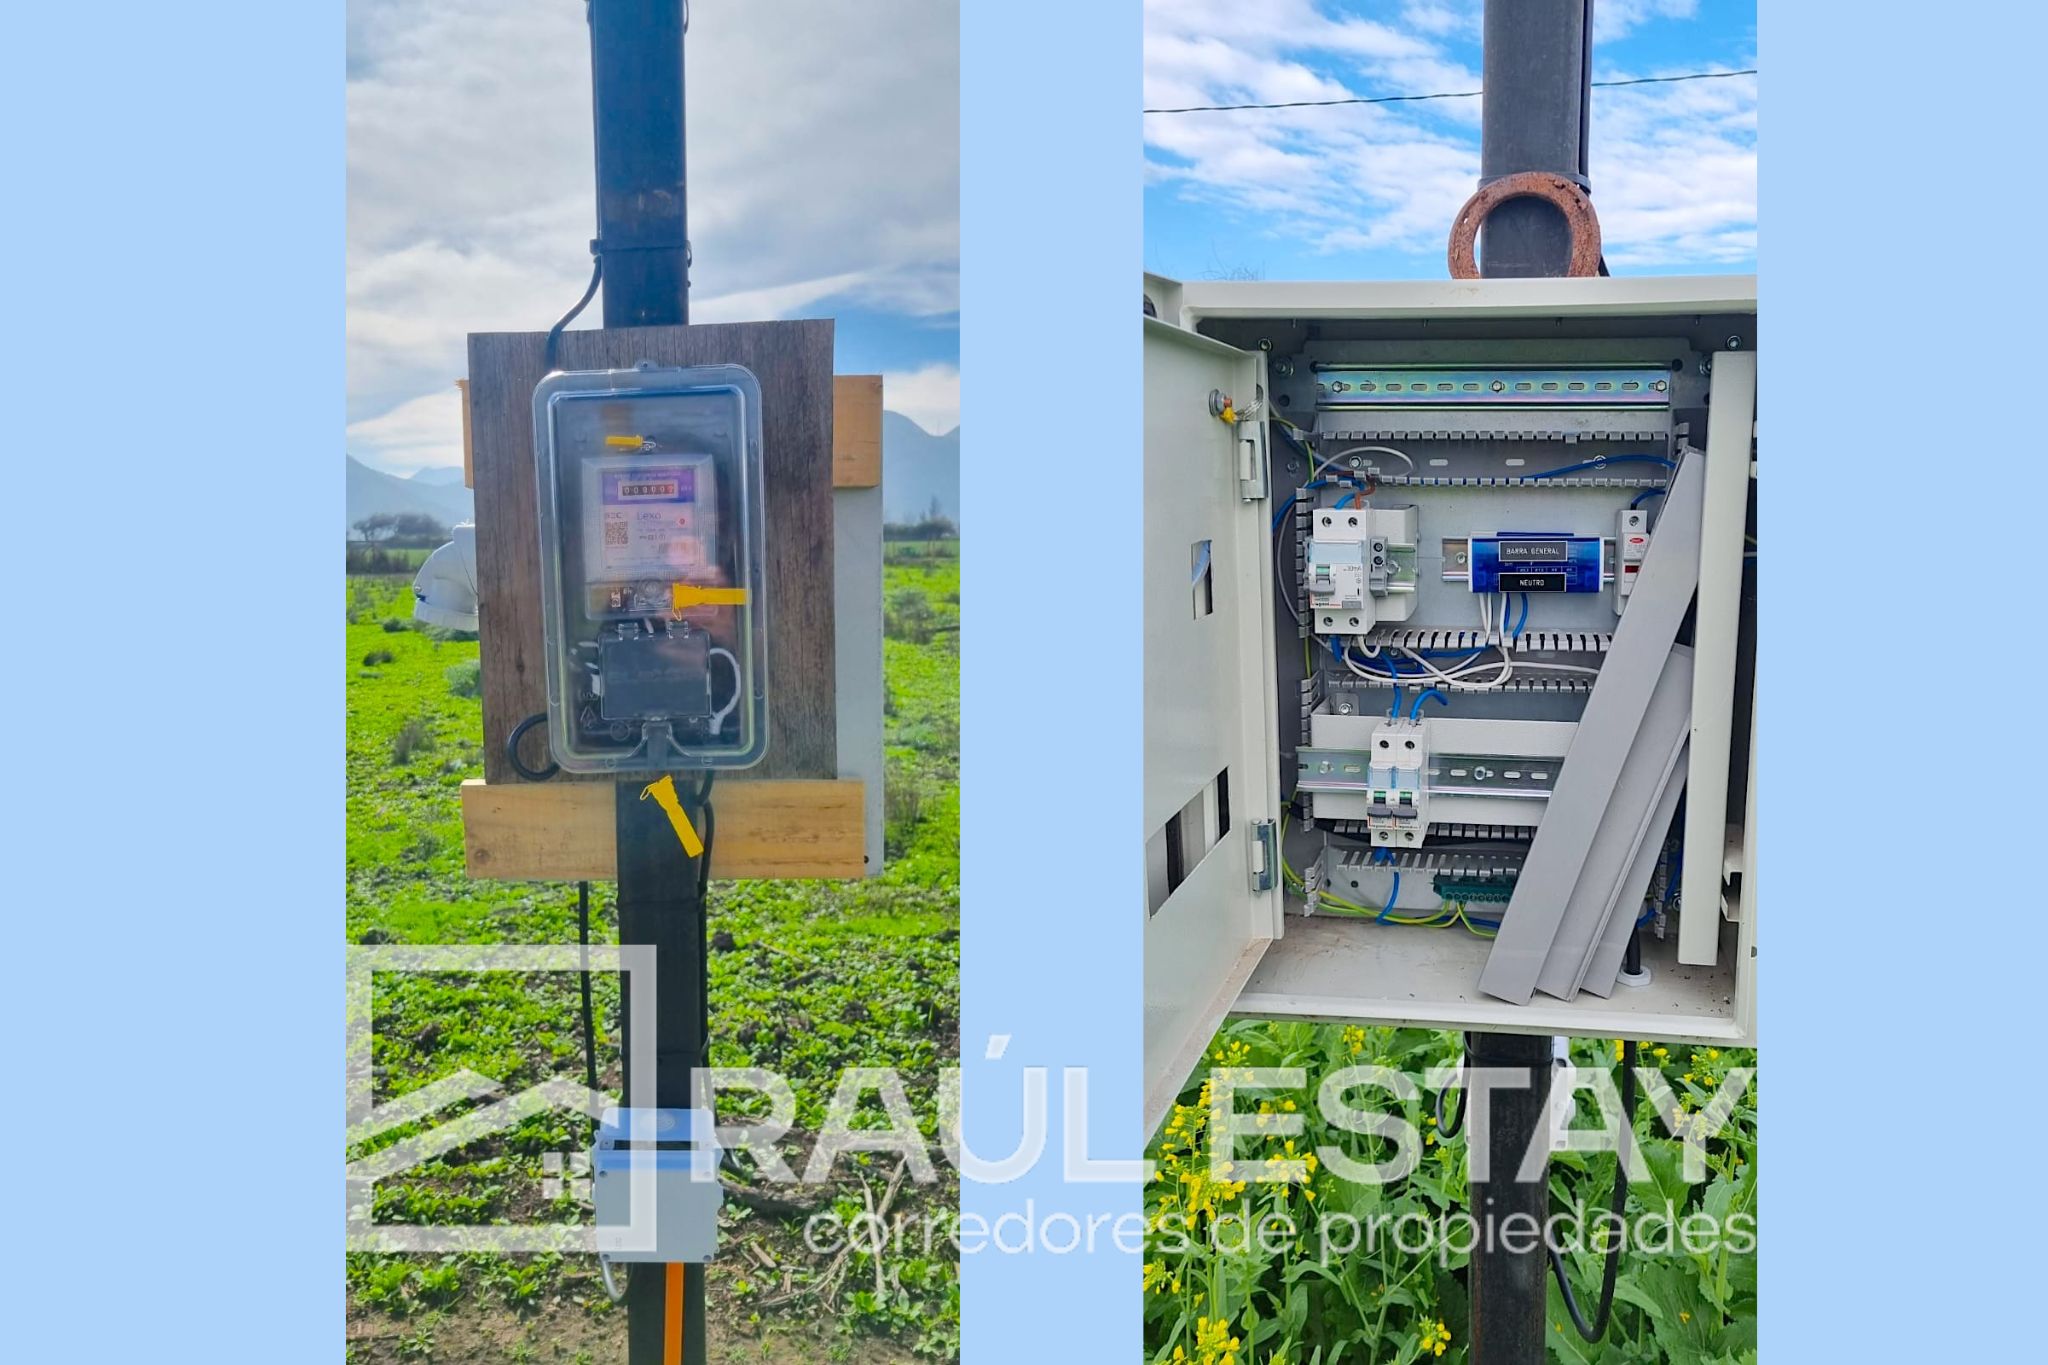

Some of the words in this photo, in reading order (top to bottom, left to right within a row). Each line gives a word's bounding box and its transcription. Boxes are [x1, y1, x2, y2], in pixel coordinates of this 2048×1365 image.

[1506, 547, 1528, 555] BARRA
[1530, 547, 1560, 555] GENERAL
[1519, 579, 1545, 587] NEUTRO
